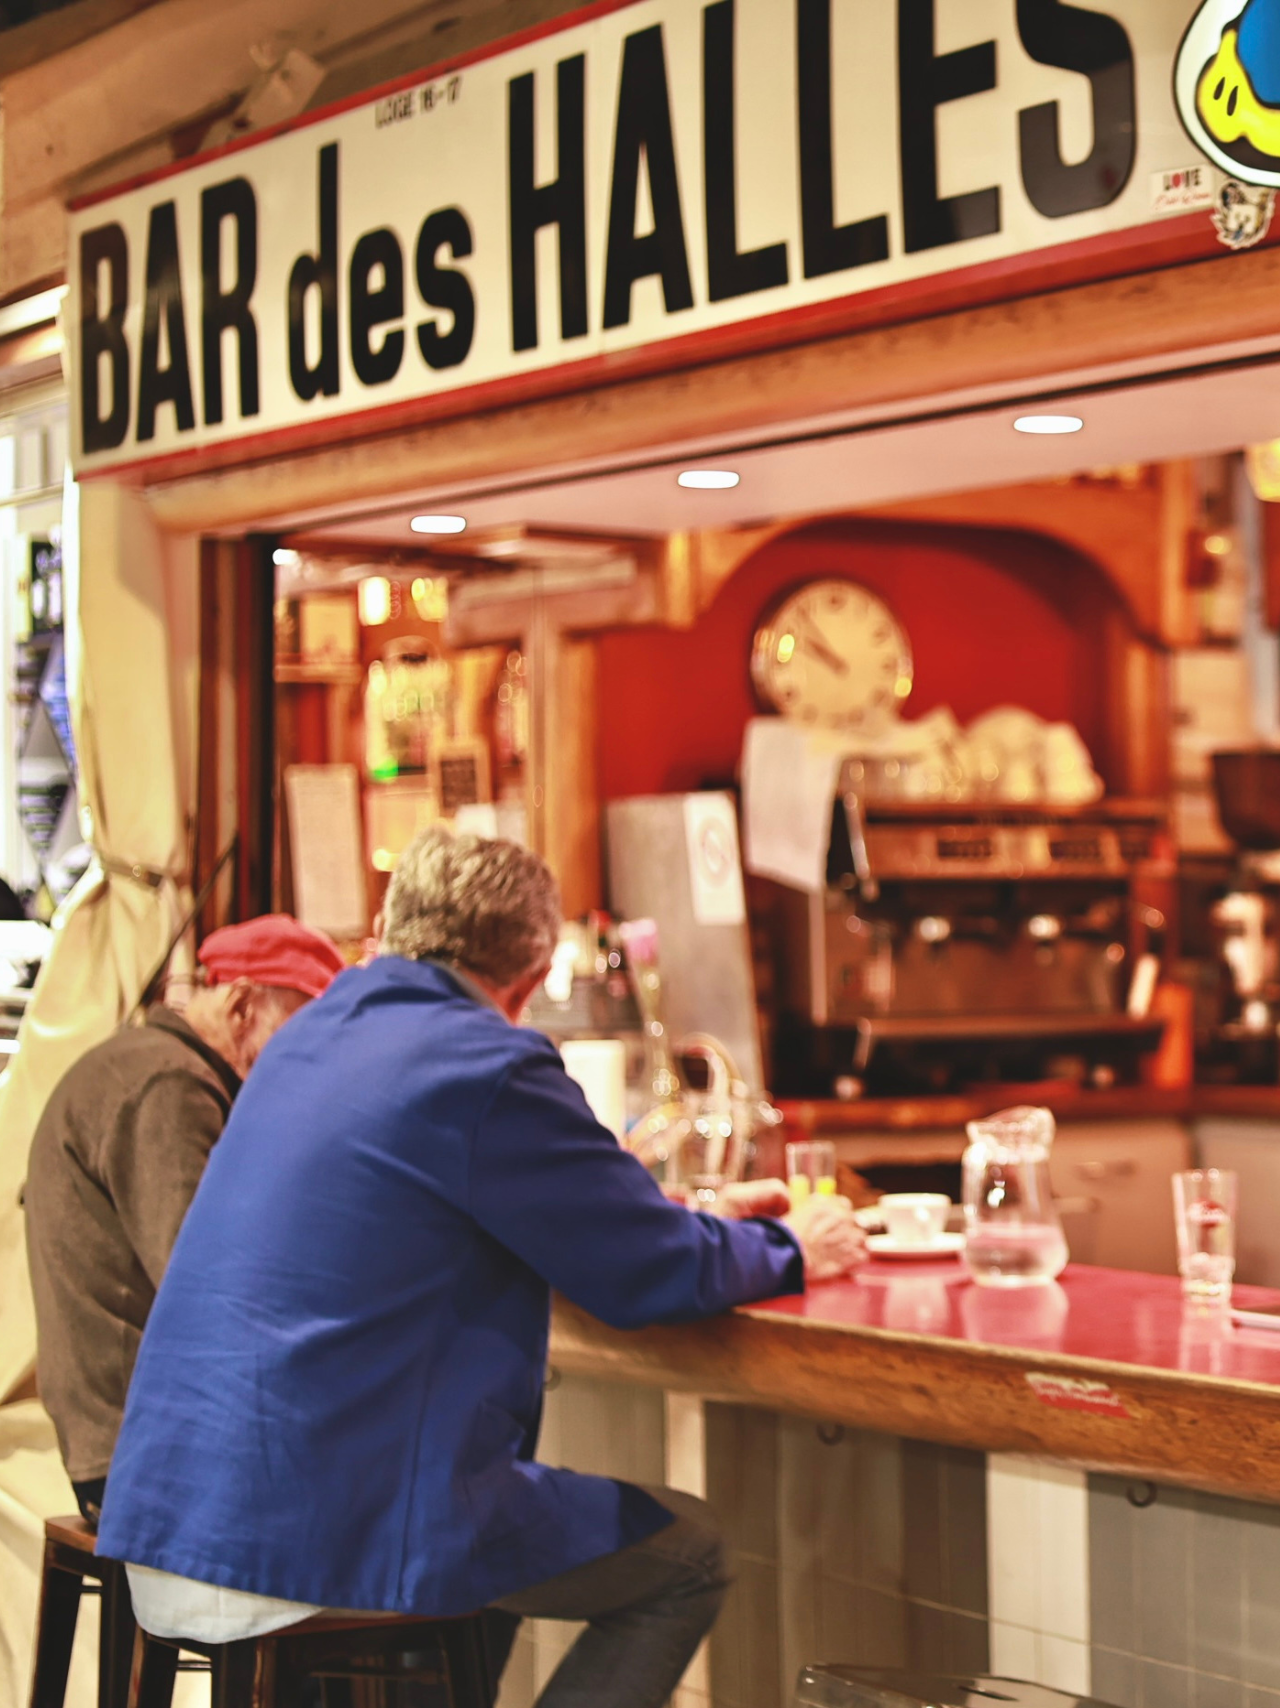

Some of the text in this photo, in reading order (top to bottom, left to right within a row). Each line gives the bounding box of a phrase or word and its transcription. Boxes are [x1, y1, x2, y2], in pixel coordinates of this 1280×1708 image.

[79, 0, 1136, 455] BAR des HALLES
